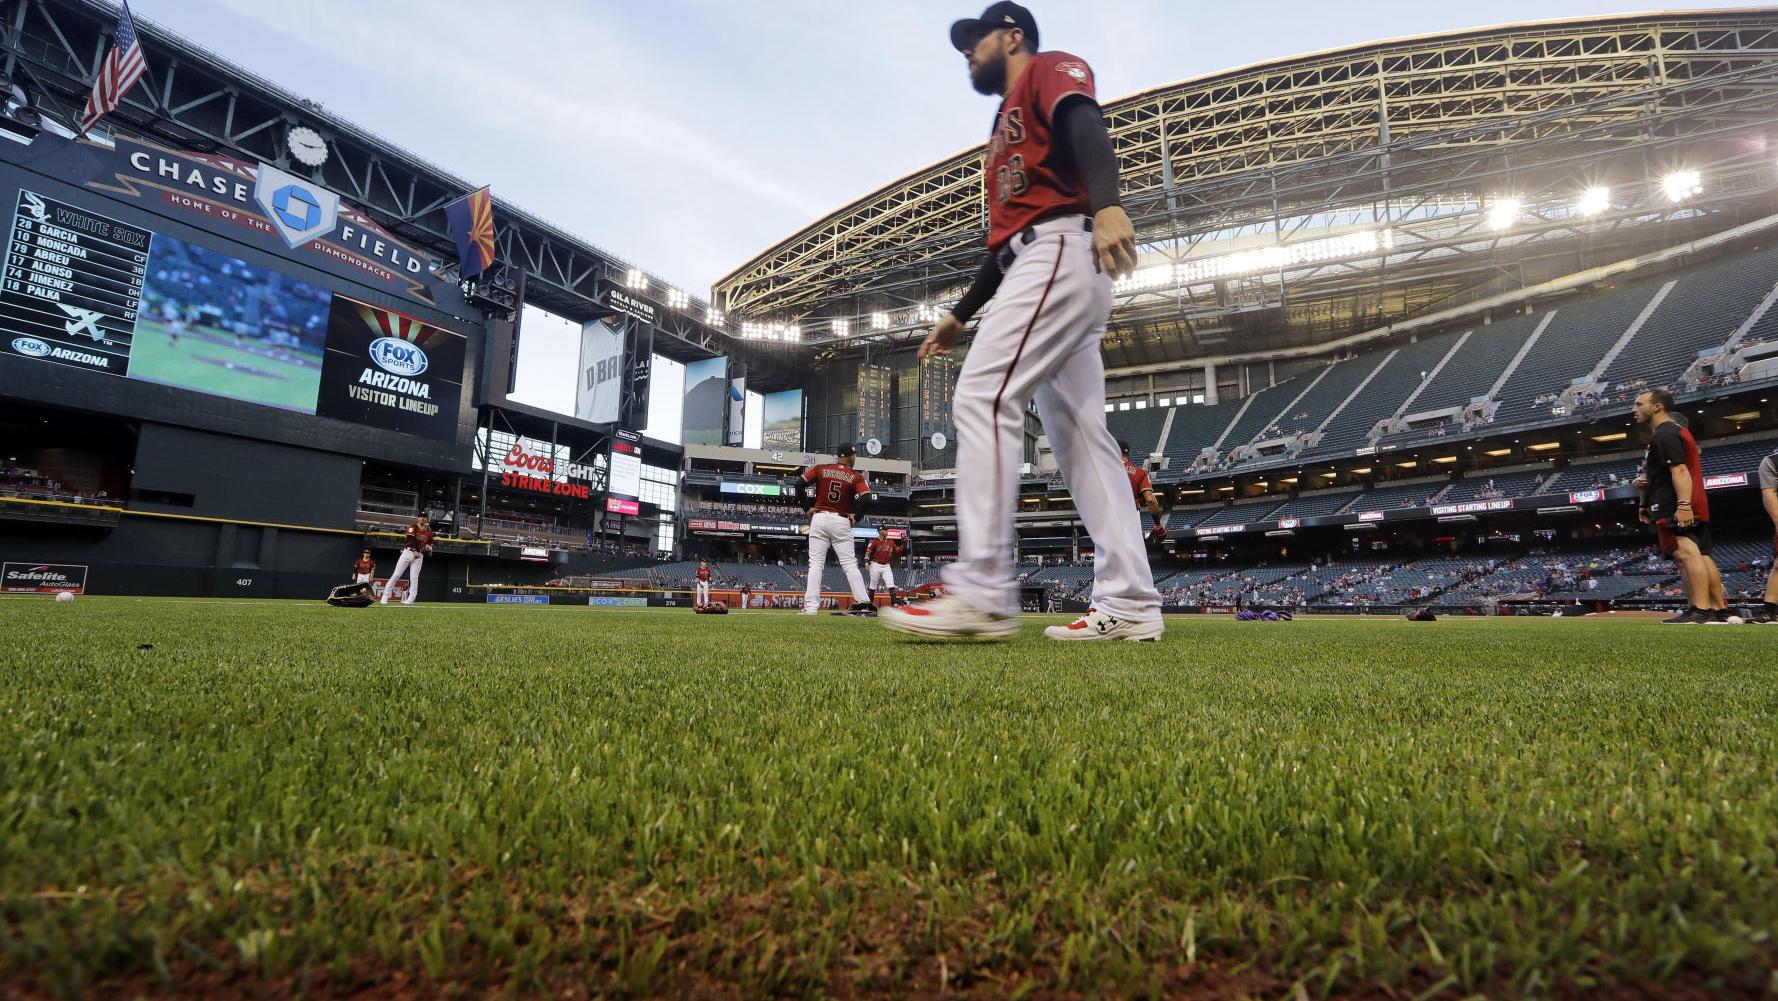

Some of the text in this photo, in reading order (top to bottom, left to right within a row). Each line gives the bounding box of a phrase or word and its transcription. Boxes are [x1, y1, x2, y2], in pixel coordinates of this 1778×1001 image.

[130, 152, 247, 202] CHASE
[57, 207, 146, 248] WHITE SOX
[171, 195, 272, 232] HOME OF THE
[16, 231, 144, 275] 10 MONCADA 3B
[18, 218, 146, 263] 28 GARCIA CF
[341, 225, 421, 273] FIELD
[11, 255, 140, 297] 17 ALONSO DH
[13, 242, 142, 286] 79 ABREU 1B
[314, 242, 392, 280] DIAMONDBACKS
[6, 279, 137, 320] 18 PALKA RF
[8, 266, 138, 308] 74 JIMENEZ LF
[610, 290, 654, 315] GILA RIVER
[51, 347, 109, 368] ARIZONA
[382, 341, 416, 365] FOX
[382, 355, 415, 371] SPORTS
[359, 367, 430, 399] ARIZONA
[348, 384, 439, 417] VISITOR LINEUP
[504, 443, 555, 473] Coors
[771, 452, 784, 462] 42
[501, 471, 589, 499] STRIKE ZONE
[736, 483, 765, 495] COX
[827, 480, 843, 503] 5
[1706, 475, 1745, 487] ARIZONA
[1432, 500, 1510, 515] VISITING STARTING LINEUP
[7, 571, 66, 581] Safelite
[39, 580, 80, 588] AutoGlass
[236, 578, 252, 587] 407
